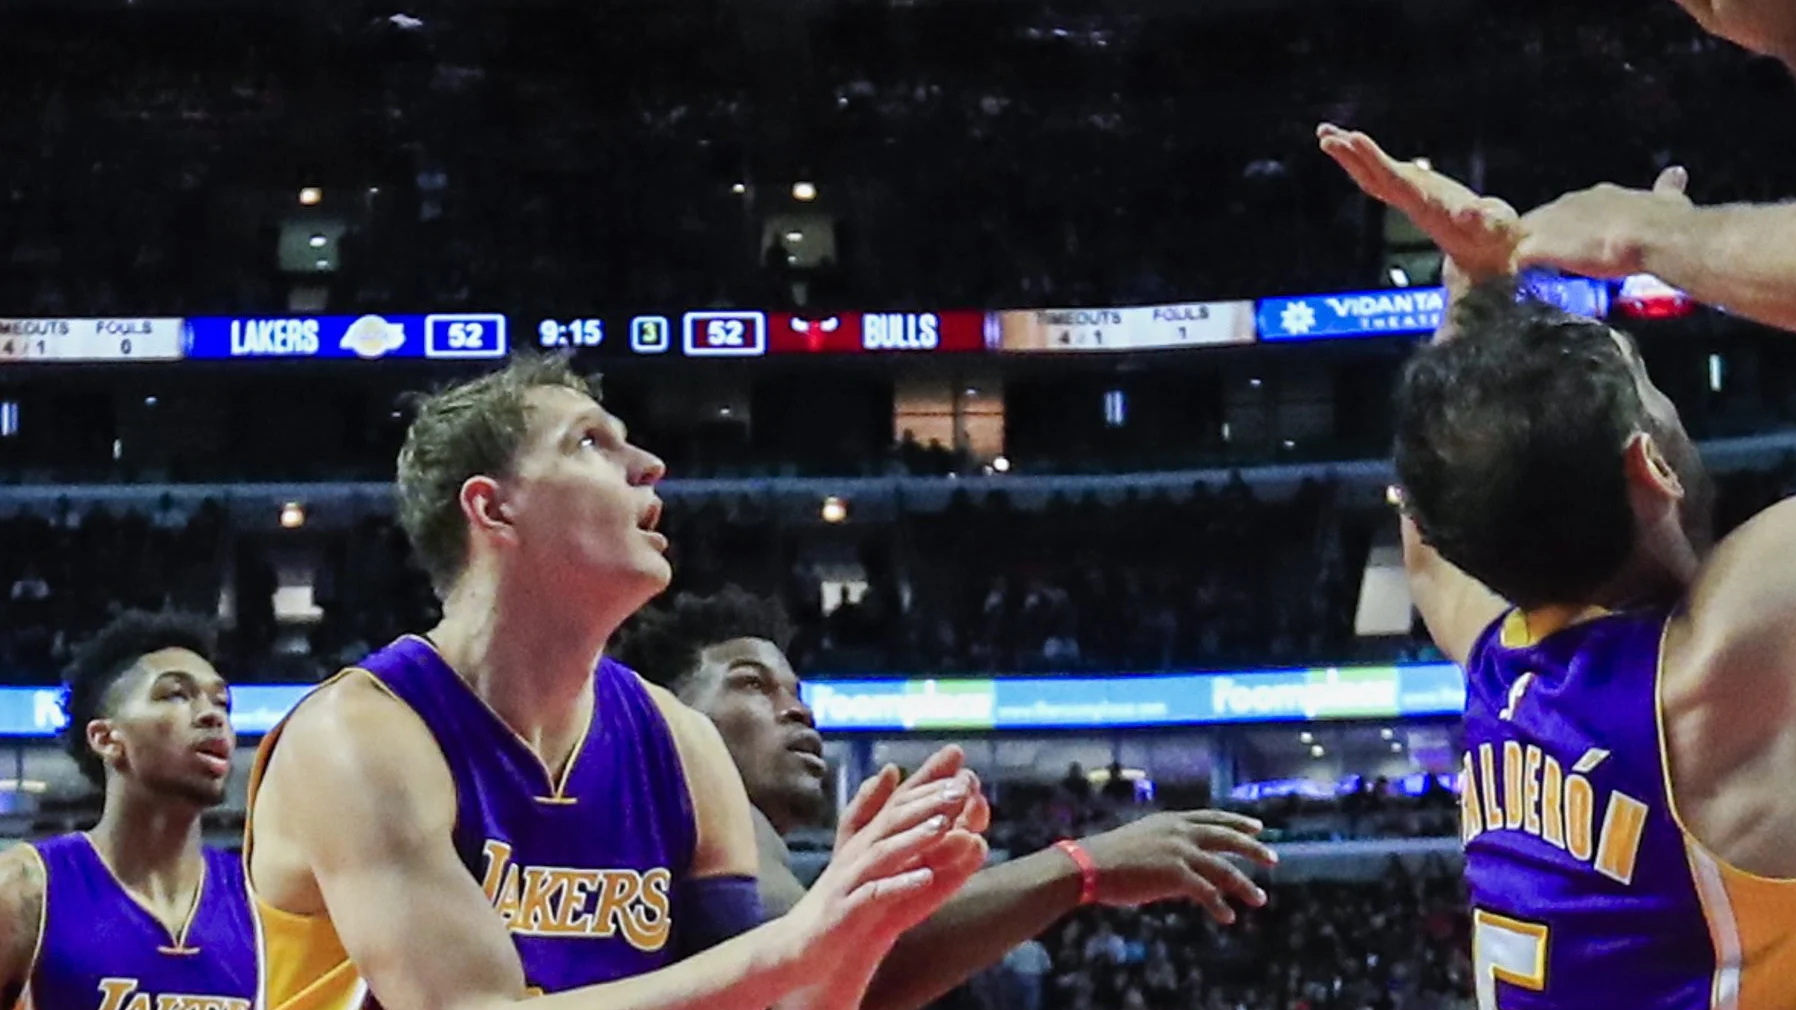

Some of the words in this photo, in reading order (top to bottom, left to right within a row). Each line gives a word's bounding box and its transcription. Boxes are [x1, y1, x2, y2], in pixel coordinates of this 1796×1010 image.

[1152, 305, 1210, 322] FOULS
[95, 320, 152, 335] FOULS
[230, 319, 319, 355] LAKERS
[447, 323, 483, 348] 52
[539, 319, 602, 346] 9:15
[642, 322, 658, 343] 3
[706, 320, 745, 347] 52
[862, 313, 938, 350] BULLS
[483, 839, 671, 951] LAKERS
